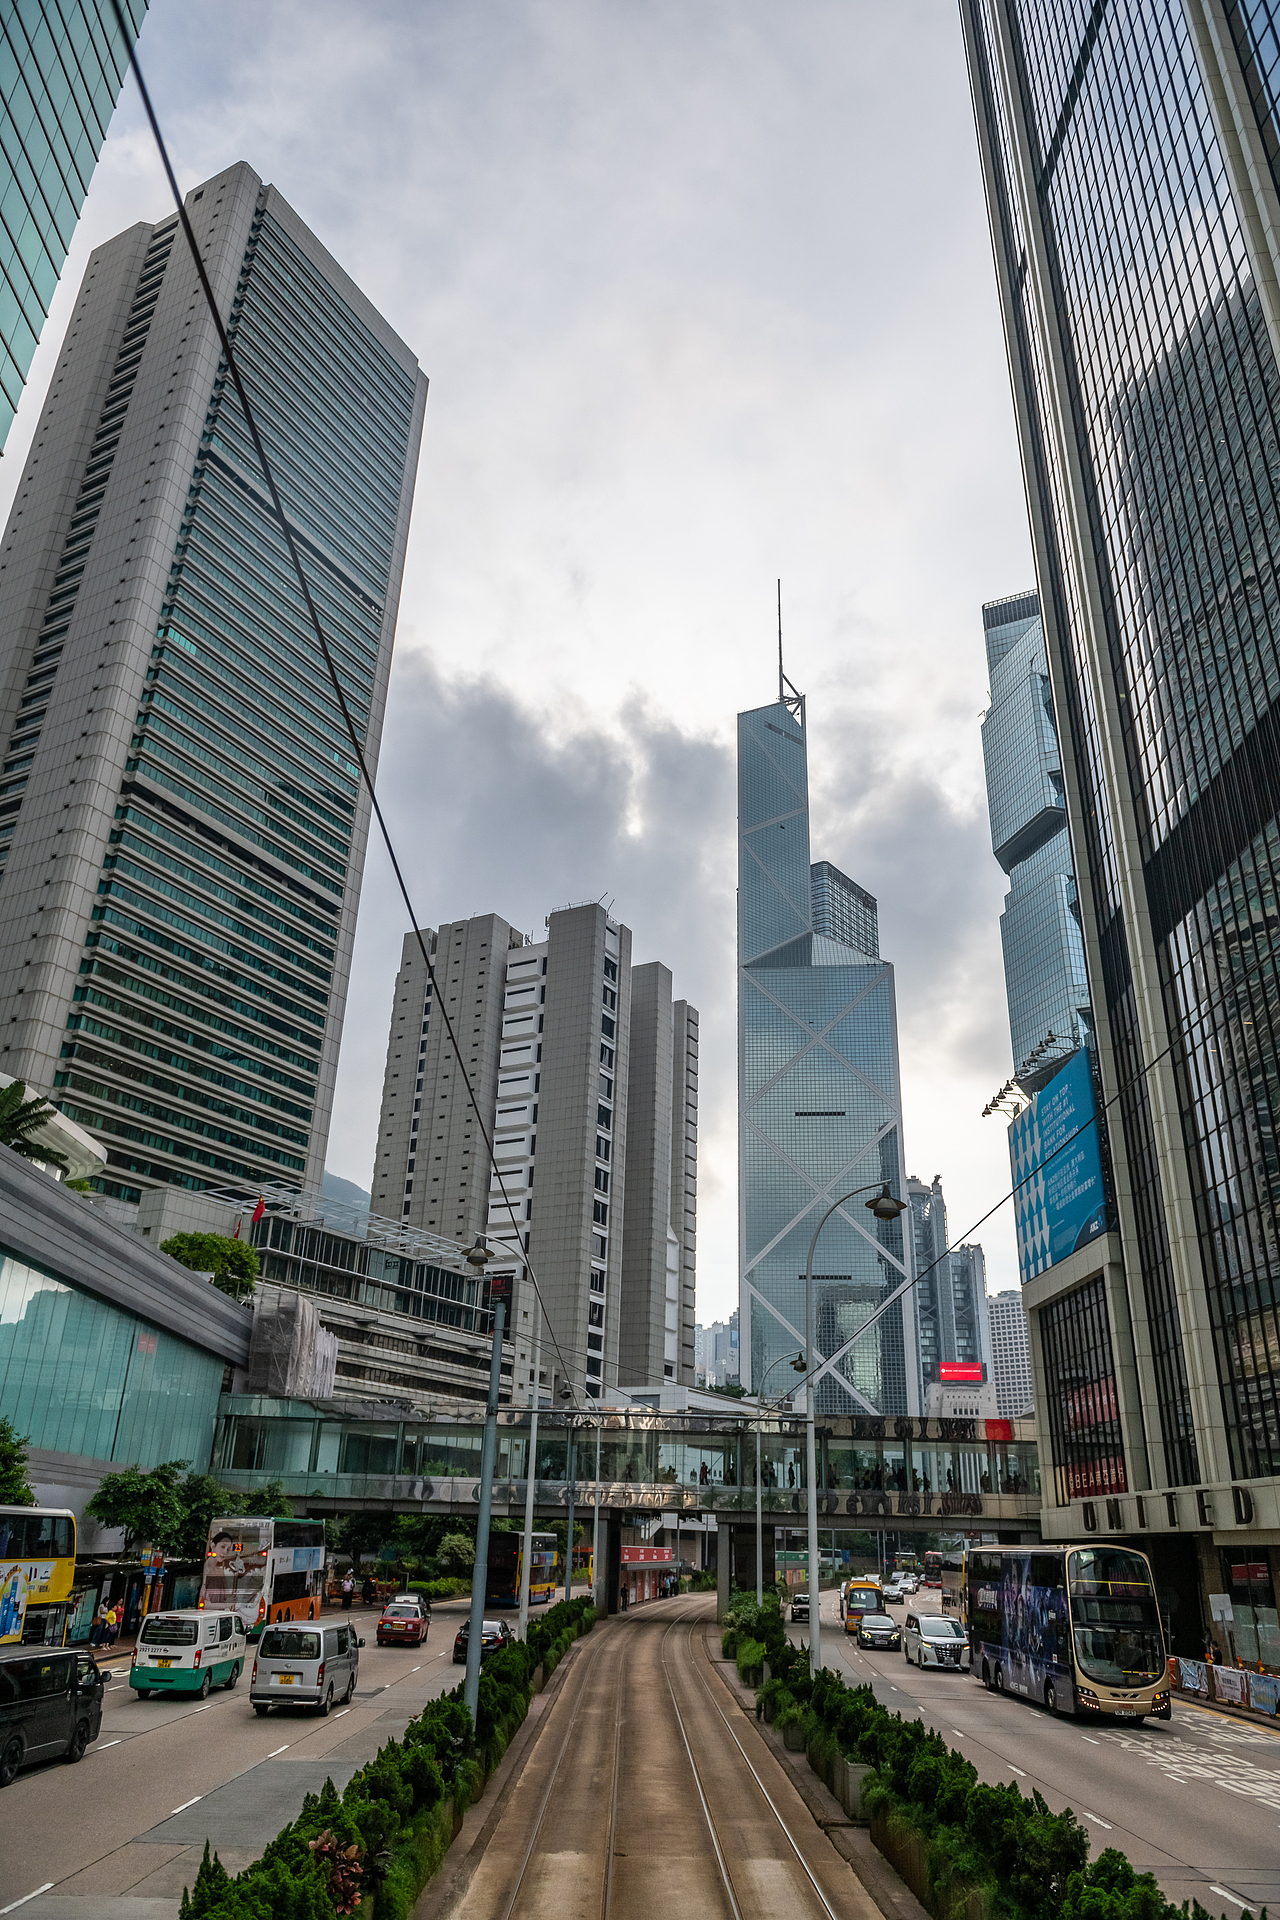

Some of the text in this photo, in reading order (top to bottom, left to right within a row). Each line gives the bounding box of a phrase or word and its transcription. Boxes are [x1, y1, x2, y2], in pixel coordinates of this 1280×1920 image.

[1041, 1083, 1069, 1117] STAY ON TOP
[1042, 1111, 1054, 1127] WITH
[1053, 1102, 1063, 1116] THE
[1043, 1102, 1076, 1139] INSTITUTIONAL
[1044, 1123, 1066, 1150] BANK FOR
[1045, 1124, 1080, 1160] RELATIONSHIPS
[1090, 1220, 1099, 1234] ANZ
[1082, 1485, 1253, 1532] UNITED
[234, 1543, 242, 1552] 23
[1126, 1748, 1255, 1767] DRIVE
[1146, 1762, 1280, 1780] USTICE
